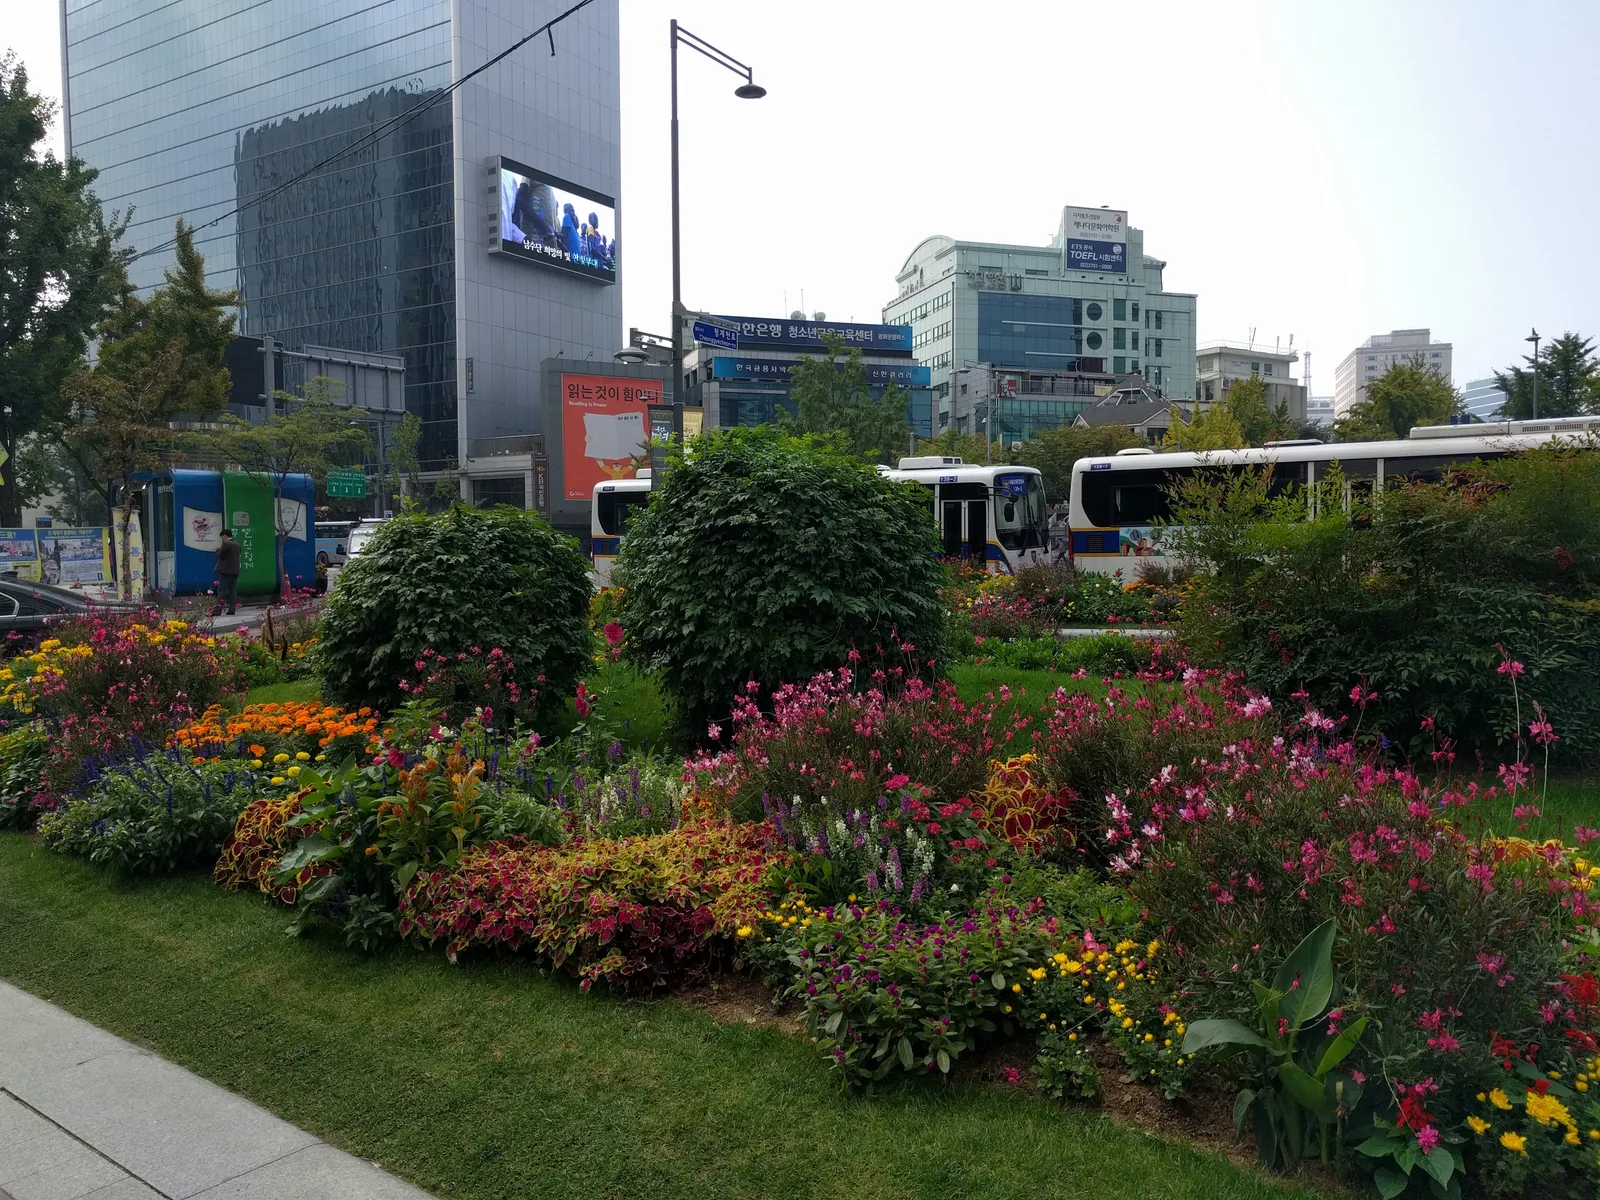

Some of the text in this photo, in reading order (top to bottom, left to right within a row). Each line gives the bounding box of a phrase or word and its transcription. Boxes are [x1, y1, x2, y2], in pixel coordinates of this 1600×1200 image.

[1073, 221, 1119, 232] 캐나다문화어학원
[523, 239, 542, 253] 남수단
[1071, 243, 1083, 251] ETS
[1070, 250, 1122, 262] TOEFL 시험센터
[738, 321, 782, 338] 한은행
